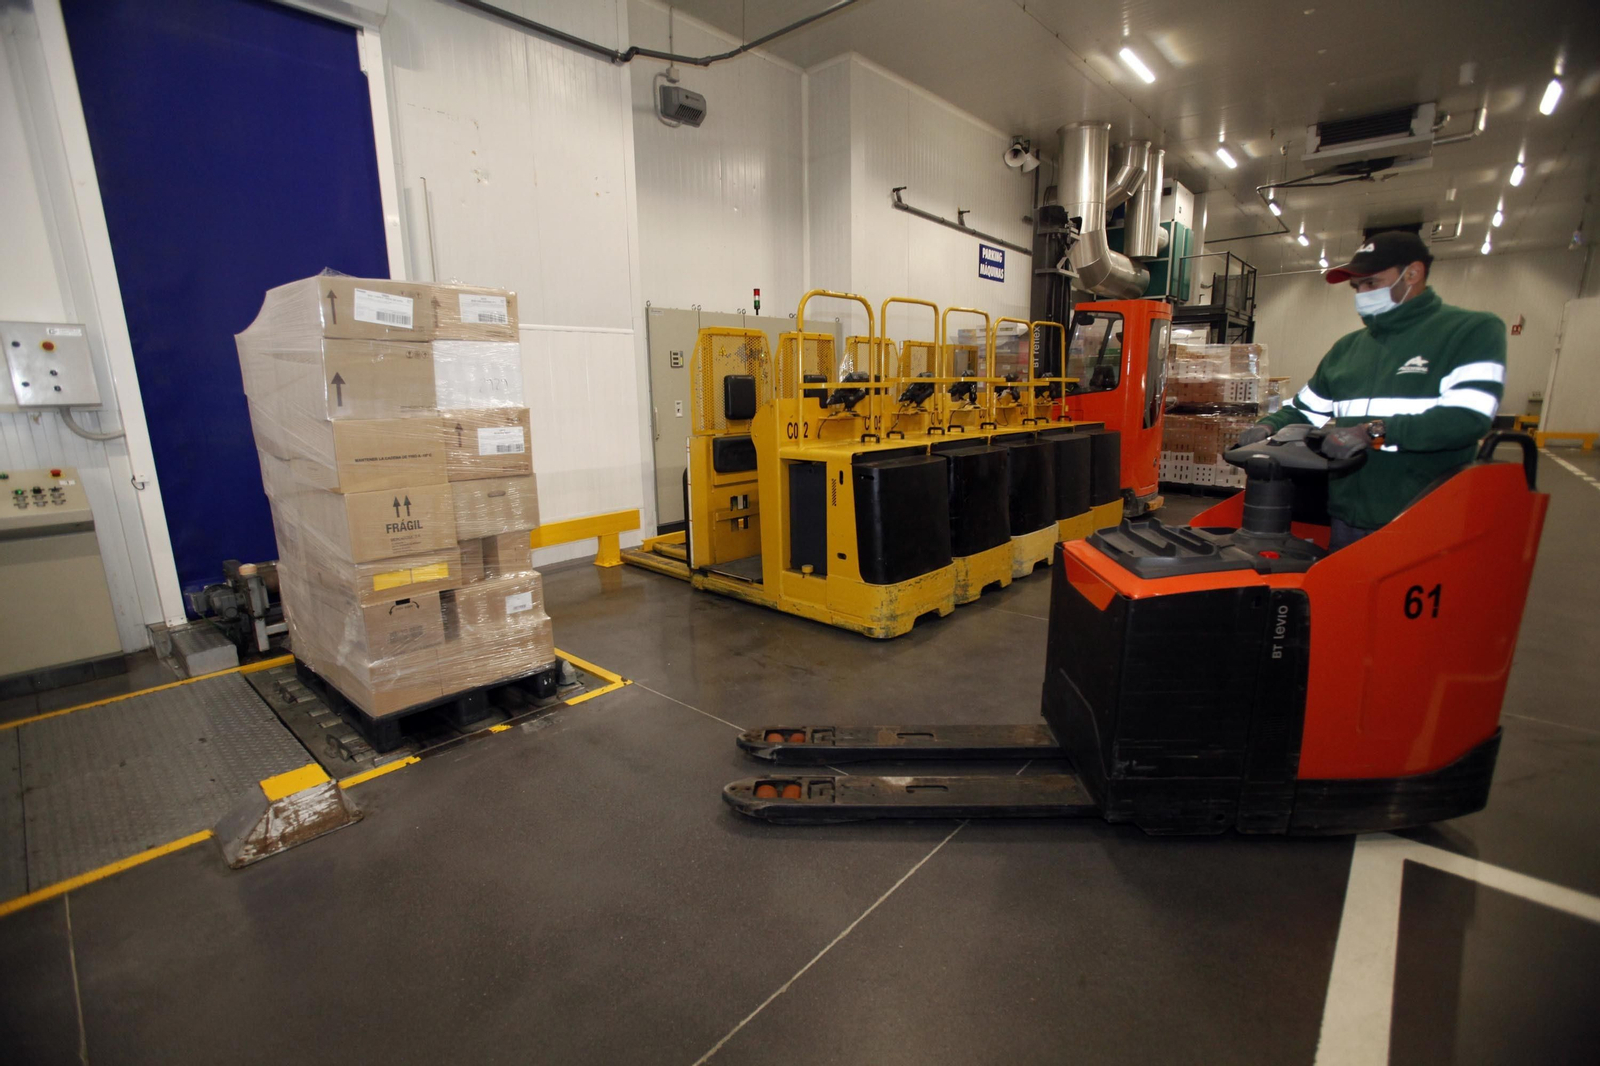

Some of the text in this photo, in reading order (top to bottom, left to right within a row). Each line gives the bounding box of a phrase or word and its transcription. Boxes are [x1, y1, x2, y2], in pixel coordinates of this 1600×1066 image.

[982, 247, 1002, 263] PARKING
[979, 261, 1004, 280] MÁQUINAS
[385, 519, 423, 534] FRÁGIL
[1403, 584, 1442, 619] 61
[1272, 645, 1283, 659] BT
